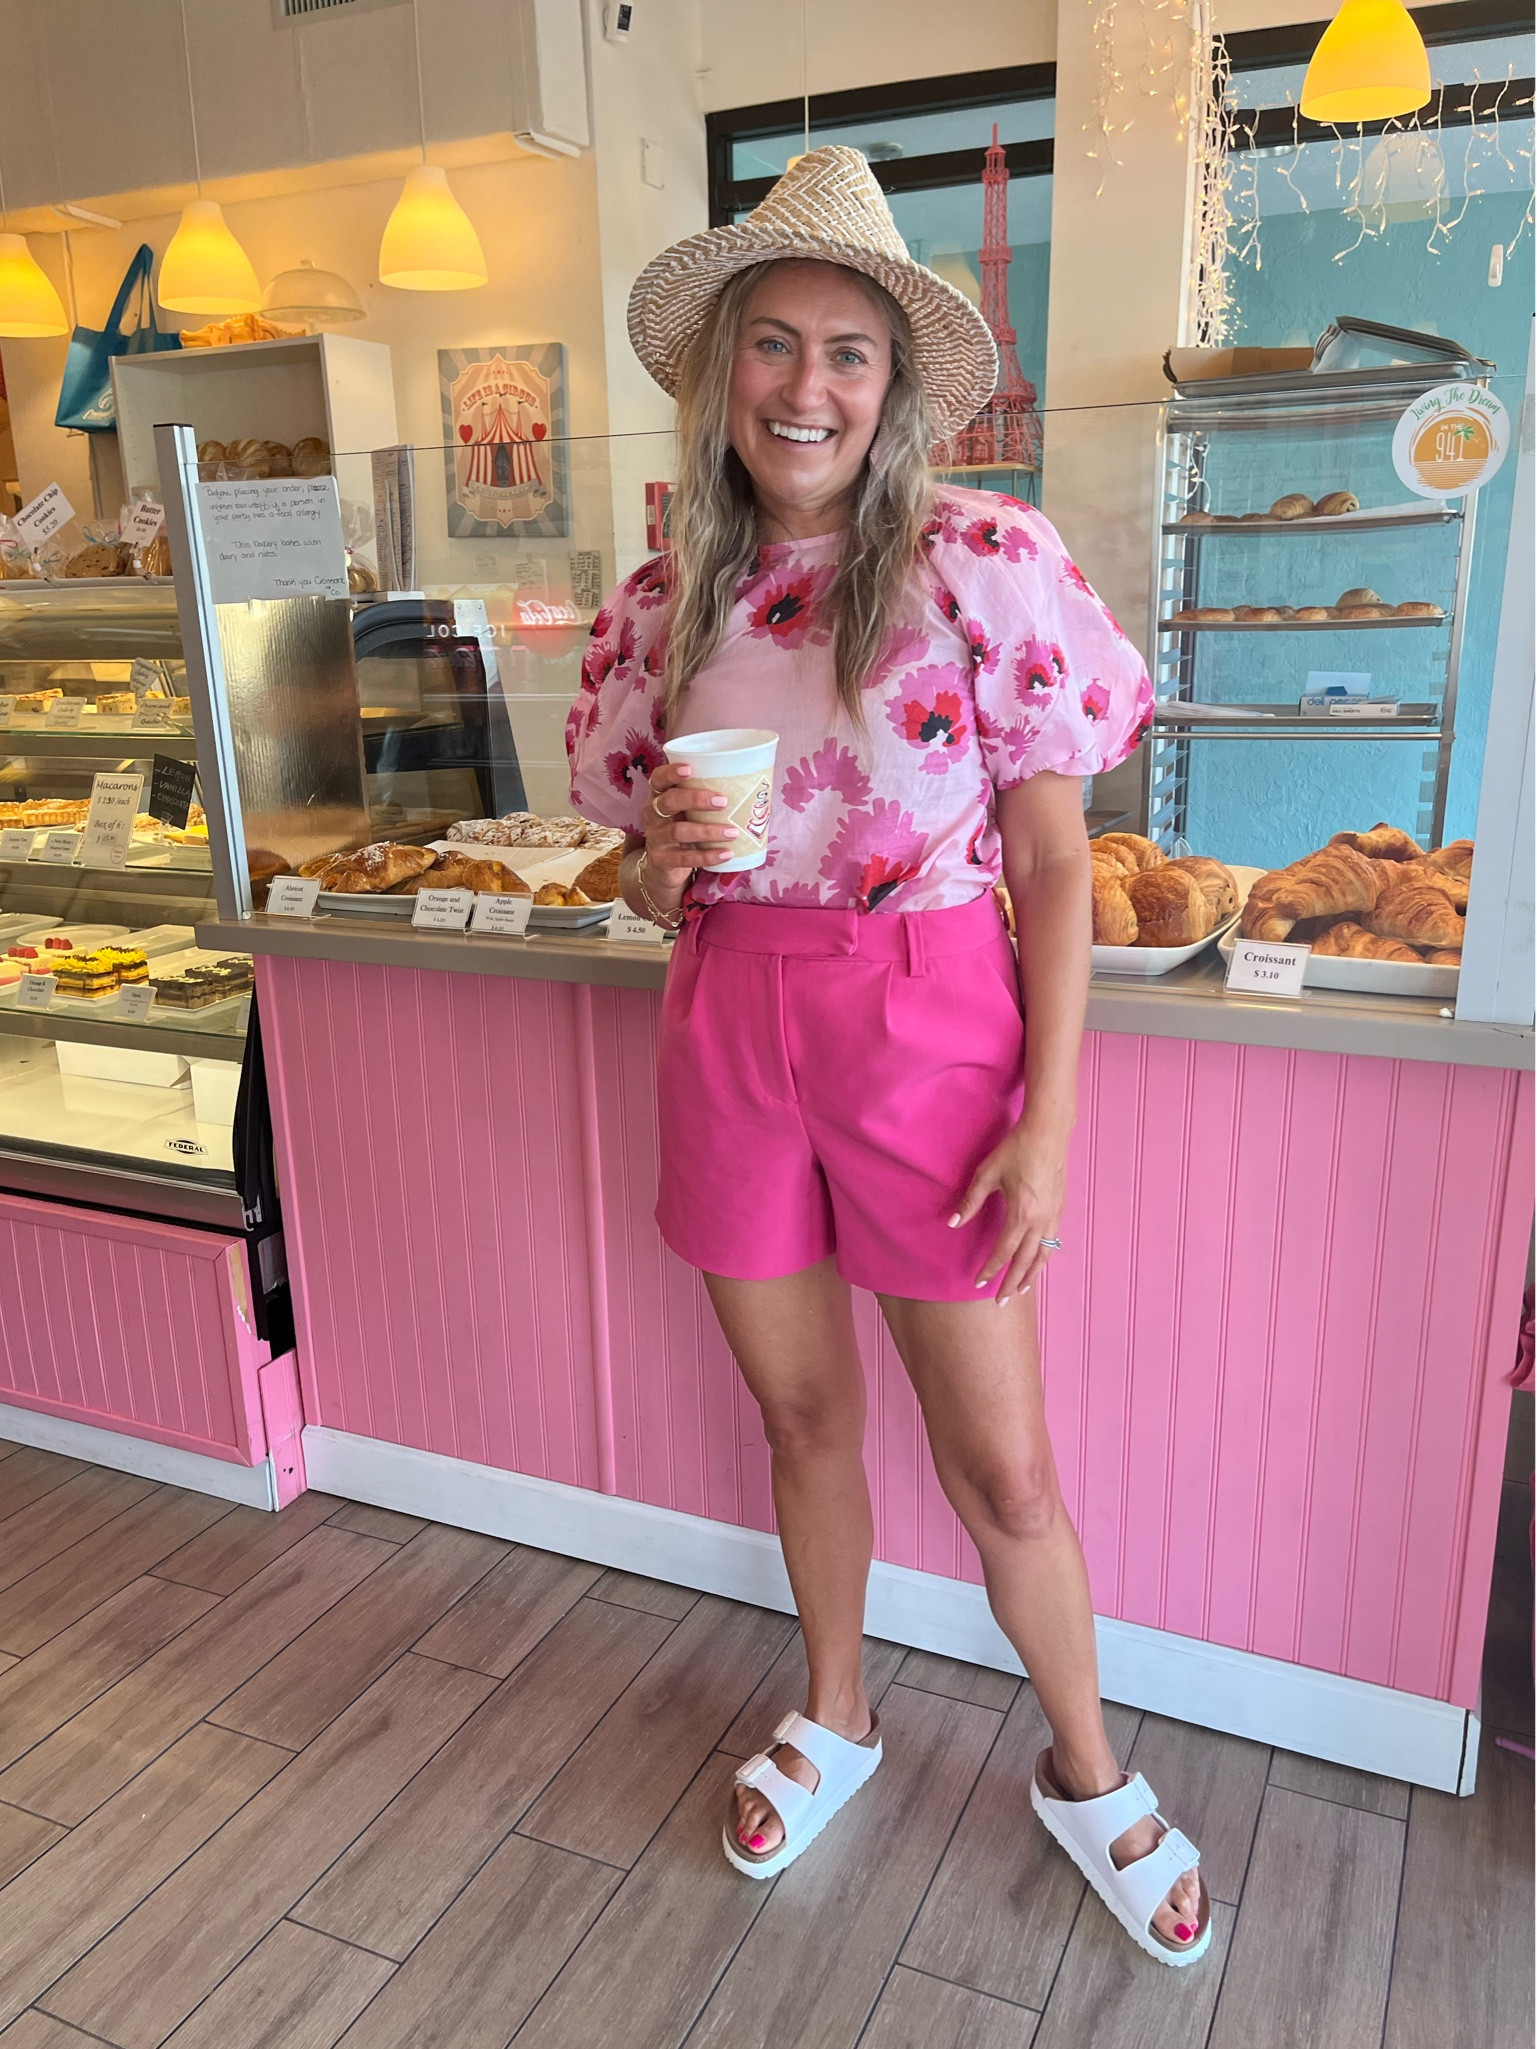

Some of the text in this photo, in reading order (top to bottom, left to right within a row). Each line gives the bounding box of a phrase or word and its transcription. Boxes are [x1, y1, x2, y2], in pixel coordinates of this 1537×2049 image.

[462, 383, 537, 411] LIFE IS A CIRCUS
[1410, 386, 1501, 421] Living The Dream
[1450, 423, 1465, 431] THE
[1435, 430, 1465, 463] 941
[202, 485, 232, 500] Before
[234, 487, 260, 498] placing
[263, 487, 278, 497] your
[17, 487, 60, 528] Chocolate Chip
[140, 504, 162, 516] Butter
[209, 503, 233, 514] inform
[248, 501, 271, 511] staff
[290, 498, 314, 508] person
[33, 506, 57, 528] Cookies
[132, 516, 158, 528] Cookies
[213, 514, 230, 525] your
[232, 512, 251, 523] party
[276, 509, 293, 519] food
[296, 510, 322, 521] allergy
[231, 541, 251, 549] This
[254, 539, 278, 550] bakery
[302, 539, 322, 547] with
[219, 552, 238, 562] dairy
[273, 577, 297, 587] Thank
[298, 579, 312, 589] you
[162, 766, 192, 783] LEMON
[96, 780, 139, 792] Macarons
[160, 780, 191, 800] VANILLA
[108, 819, 118, 832] of
[428, 894, 448, 903] Orange
[495, 898, 513, 906] Apple
[420, 904, 464, 914] Chocolate Twist
[489, 906, 516, 915] Croissant
[1244, 951, 1297, 966] Croissant
[1254, 969, 1280, 980] $ 3.10
[168, 1142, 204, 1153] FEDERAL
